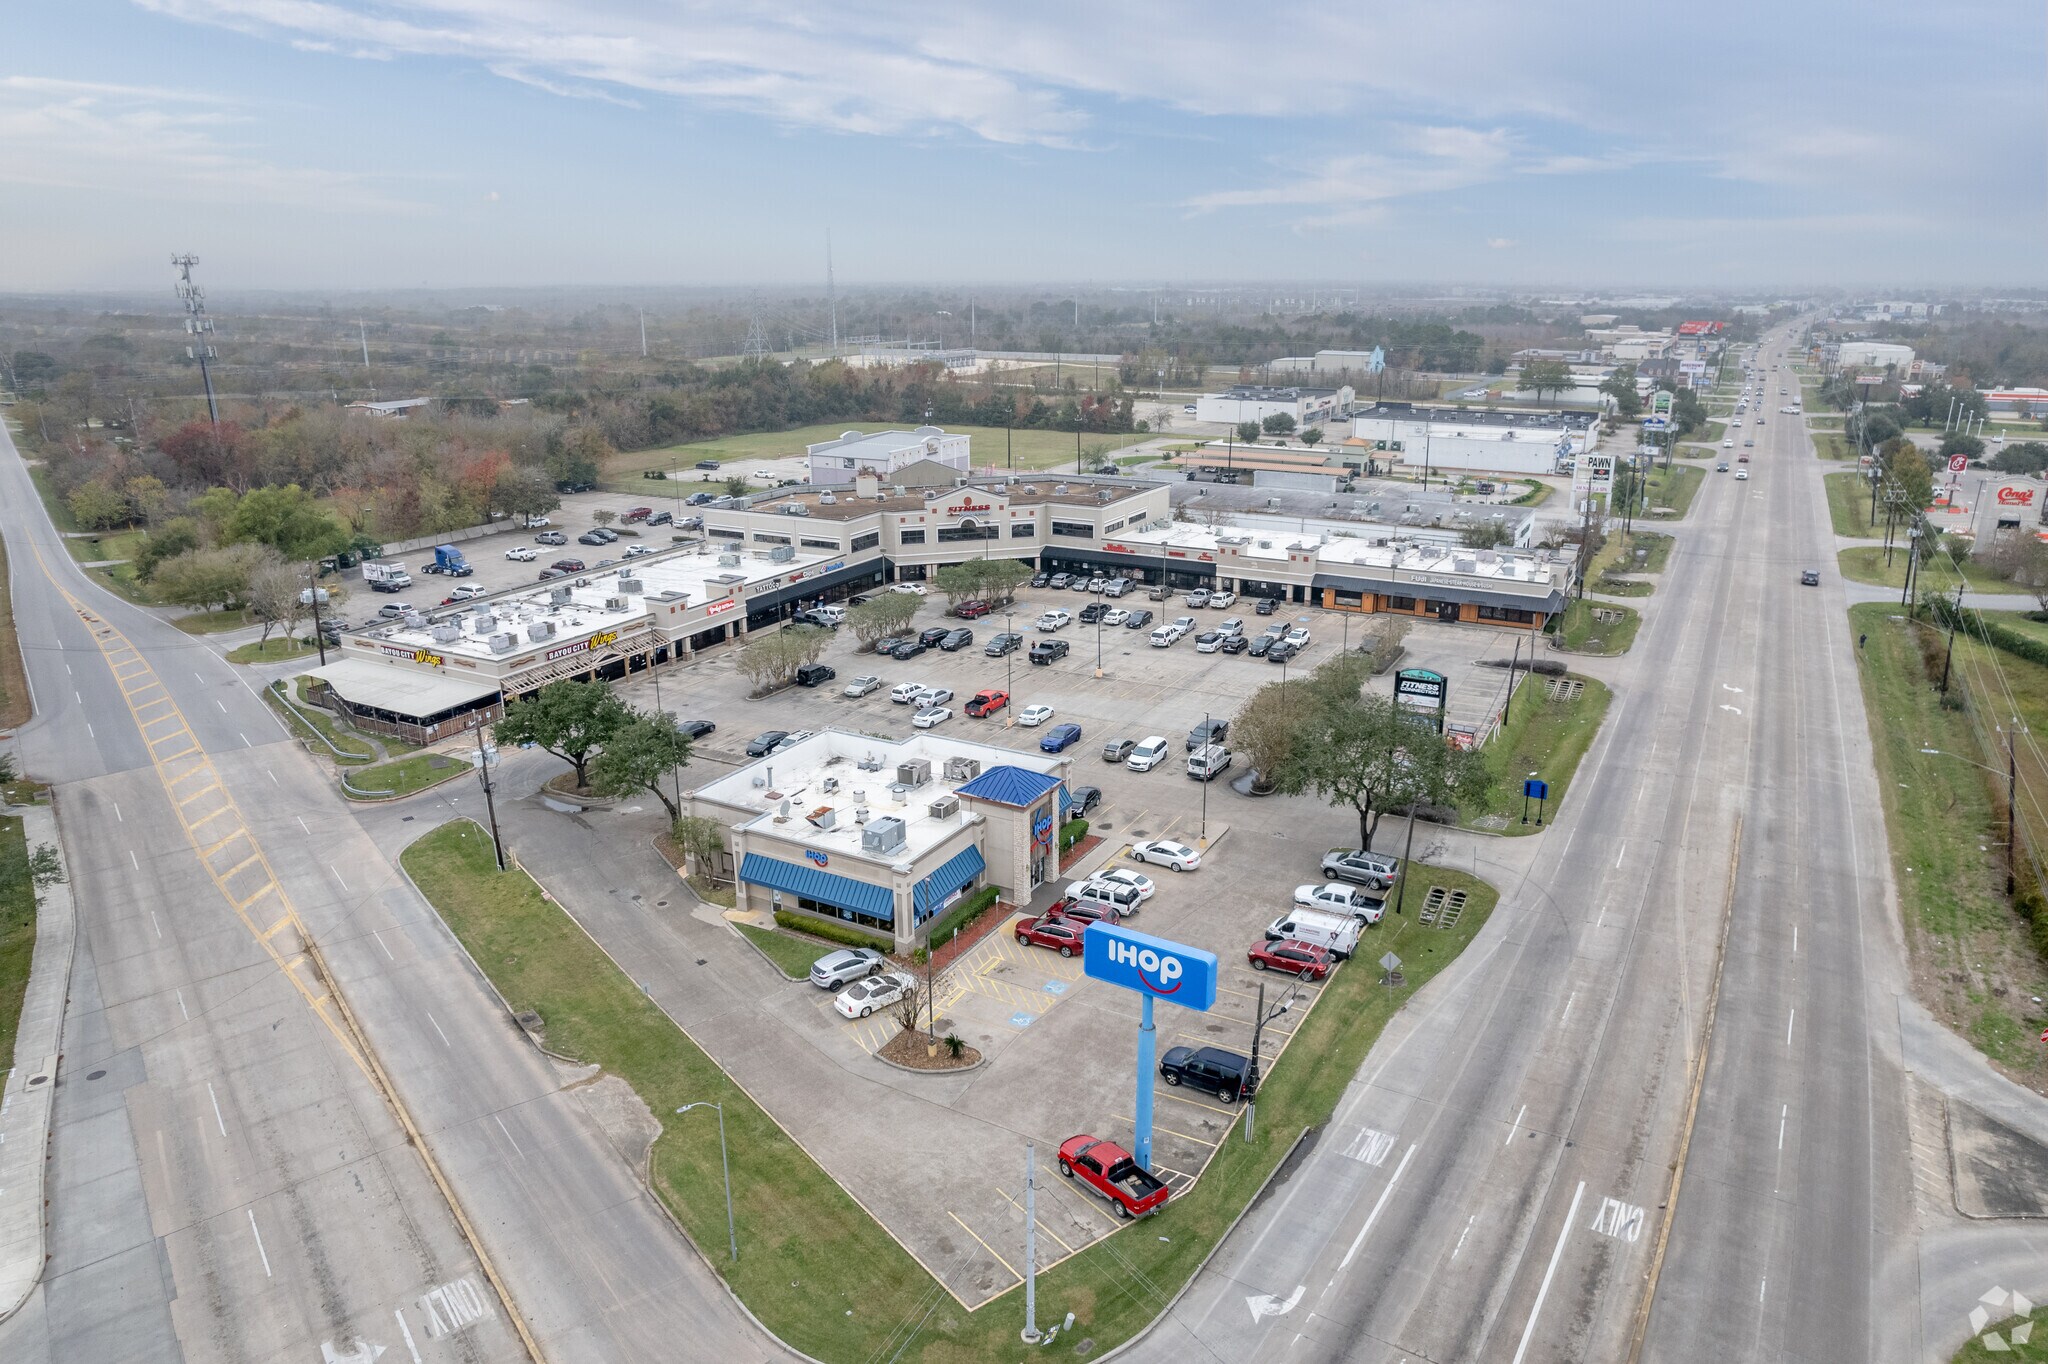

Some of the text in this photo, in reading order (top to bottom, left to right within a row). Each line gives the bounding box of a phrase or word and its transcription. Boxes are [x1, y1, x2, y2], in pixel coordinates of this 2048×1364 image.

[1588, 457, 1611, 468] PAWN
[1998, 487, 2034, 502] Conn's
[549, 631, 617, 660] BAYOU CITY Wings
[381, 646, 441, 667] BAYOU CITY Wings
[1400, 686, 1439, 695] CONNECTION
[1401, 680, 1440, 690] FITNESS
[805, 850, 828, 863] IHOP
[1108, 939, 1183, 985] IHOP
[1591, 1196, 1645, 1242] ONLY
[421, 1279, 483, 1337] ONLY
